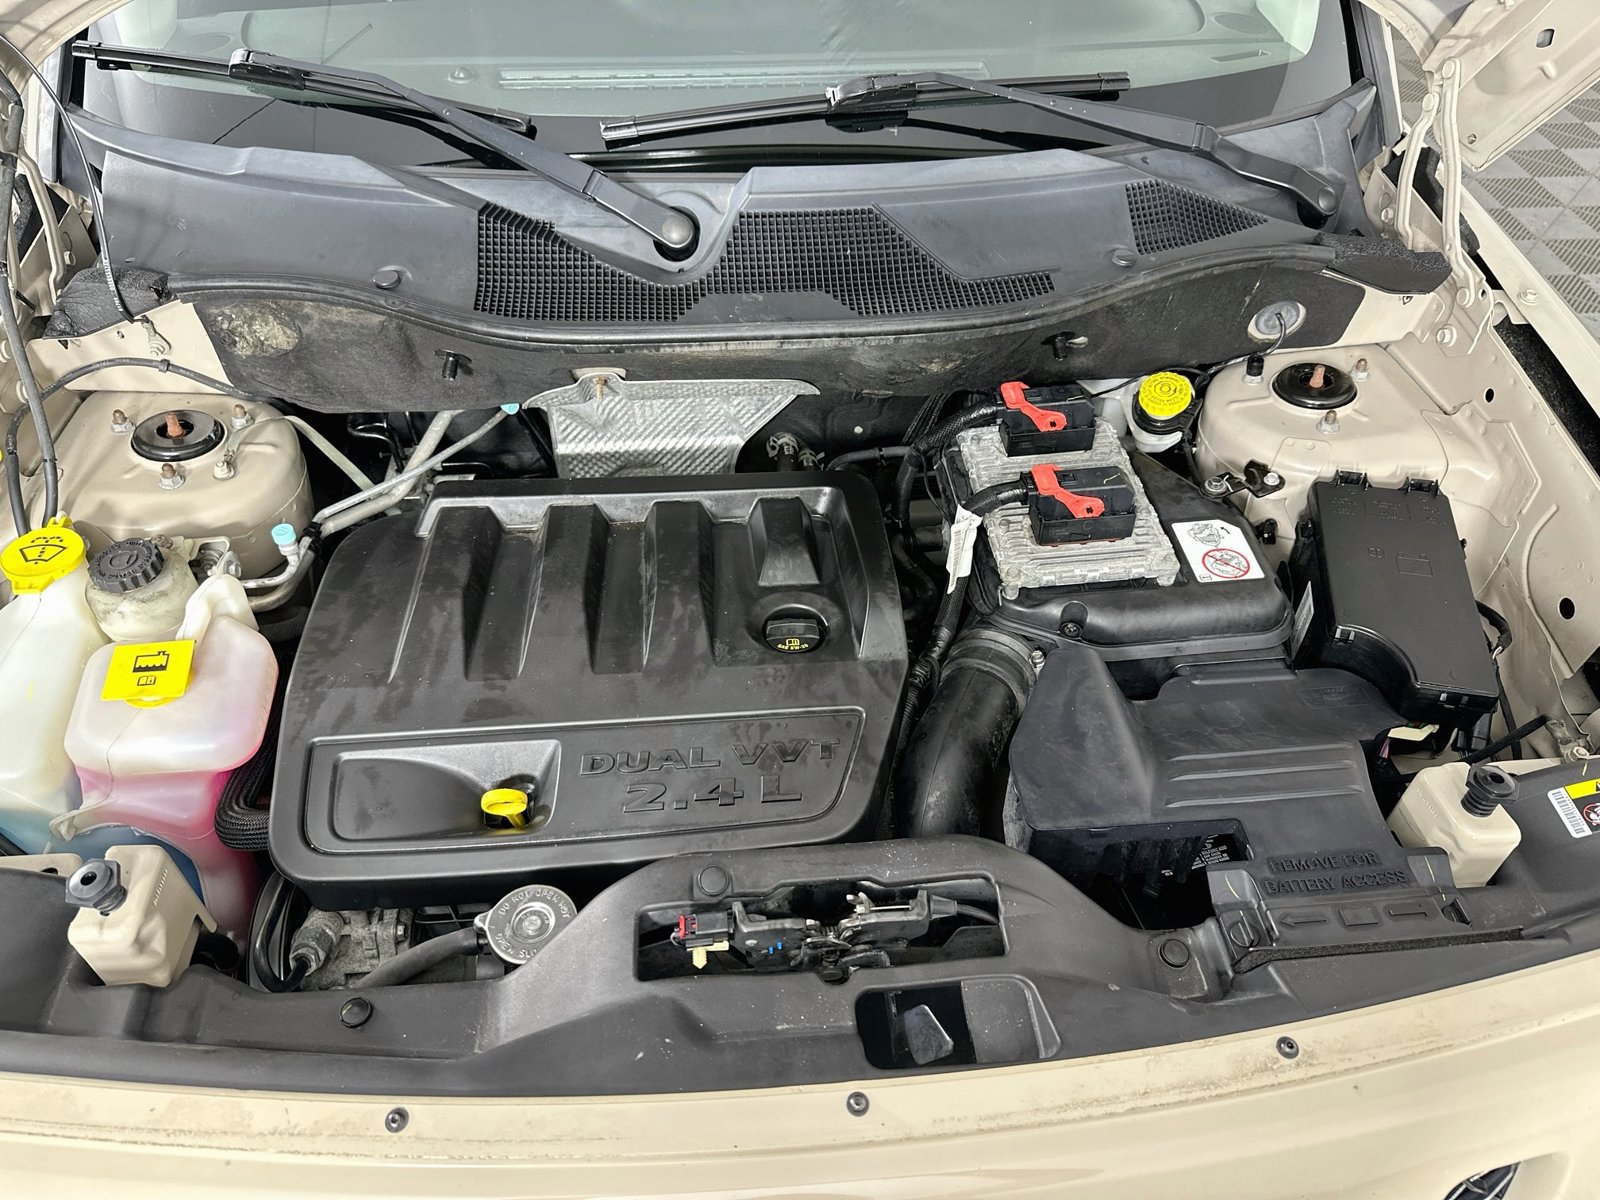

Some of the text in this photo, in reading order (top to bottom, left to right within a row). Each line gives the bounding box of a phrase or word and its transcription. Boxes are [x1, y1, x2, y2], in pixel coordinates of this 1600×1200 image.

[580, 738, 841, 776] DUAL VVT
[1269, 851, 1380, 872] REMOVE FOR
[1264, 870, 1409, 894] BATTERY ACCESS
[498, 902, 510, 916] DO
